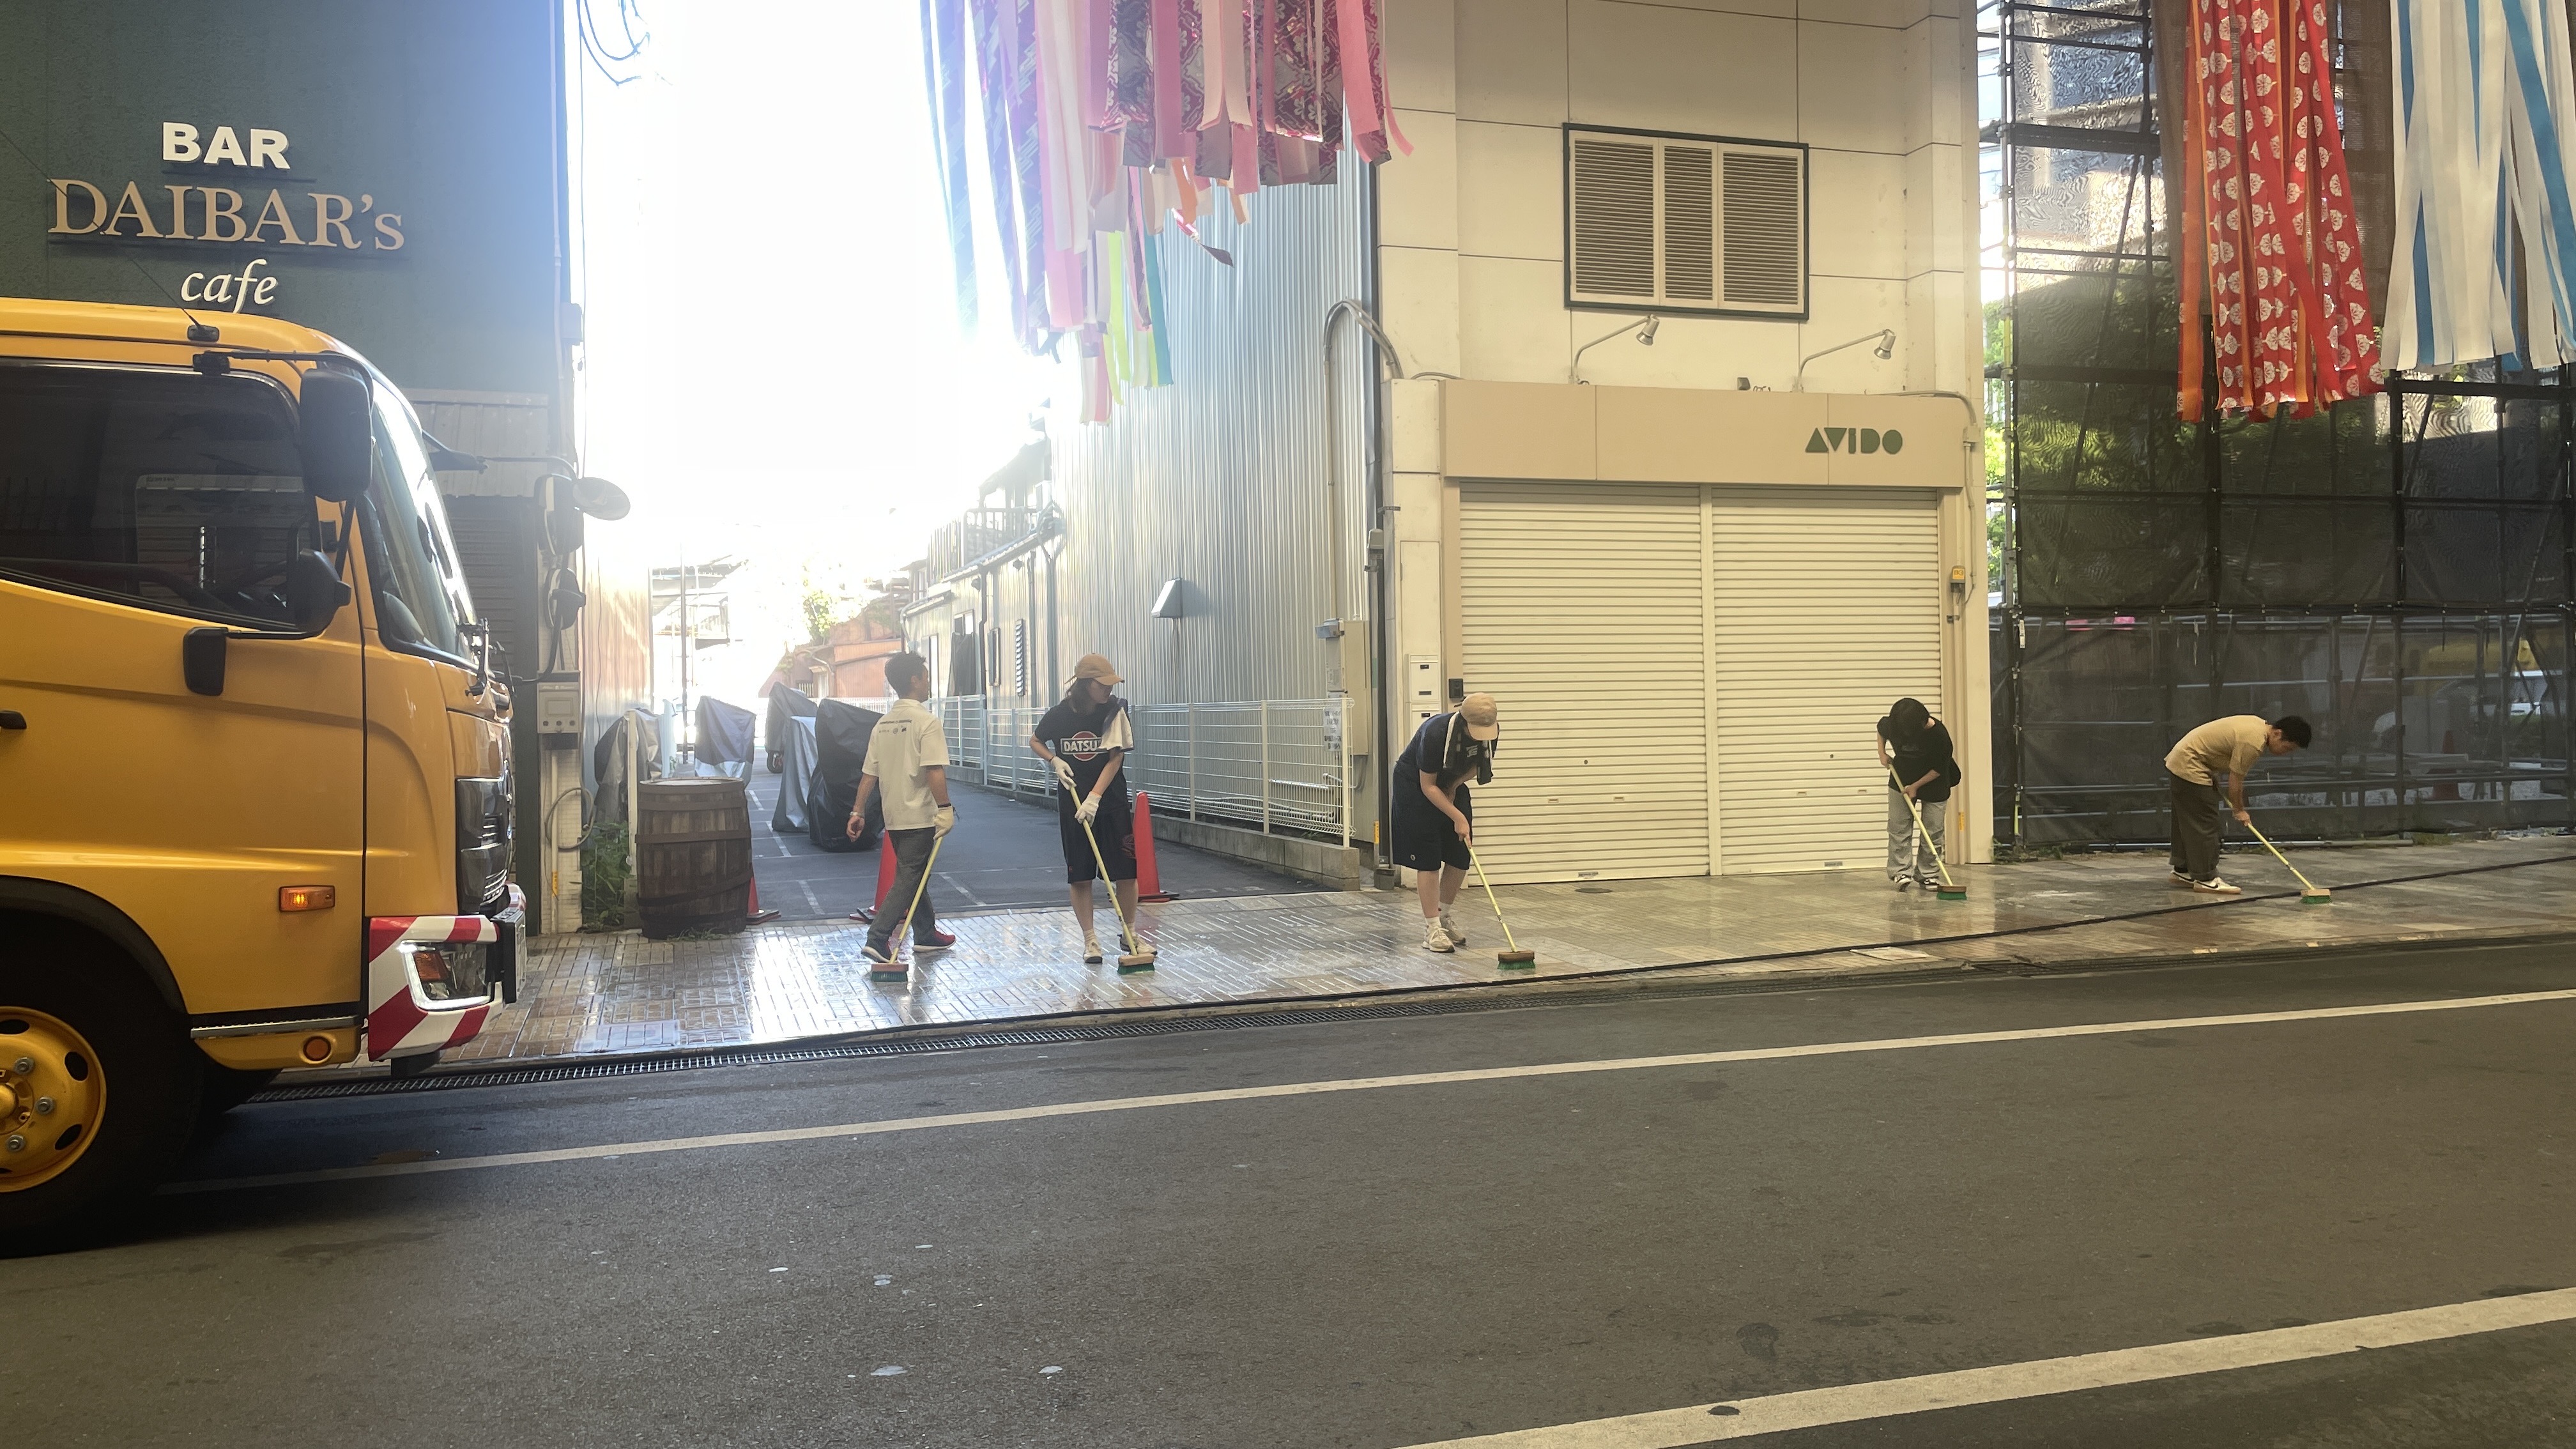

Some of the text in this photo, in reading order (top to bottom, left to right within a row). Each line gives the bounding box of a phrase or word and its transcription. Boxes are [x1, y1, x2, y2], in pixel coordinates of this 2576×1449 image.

[163, 121, 291, 170] BAR
[47, 179, 405, 250] DAIBAR's
[180, 258, 279, 313] cafe
[1064, 740, 1101, 752] DATSU
